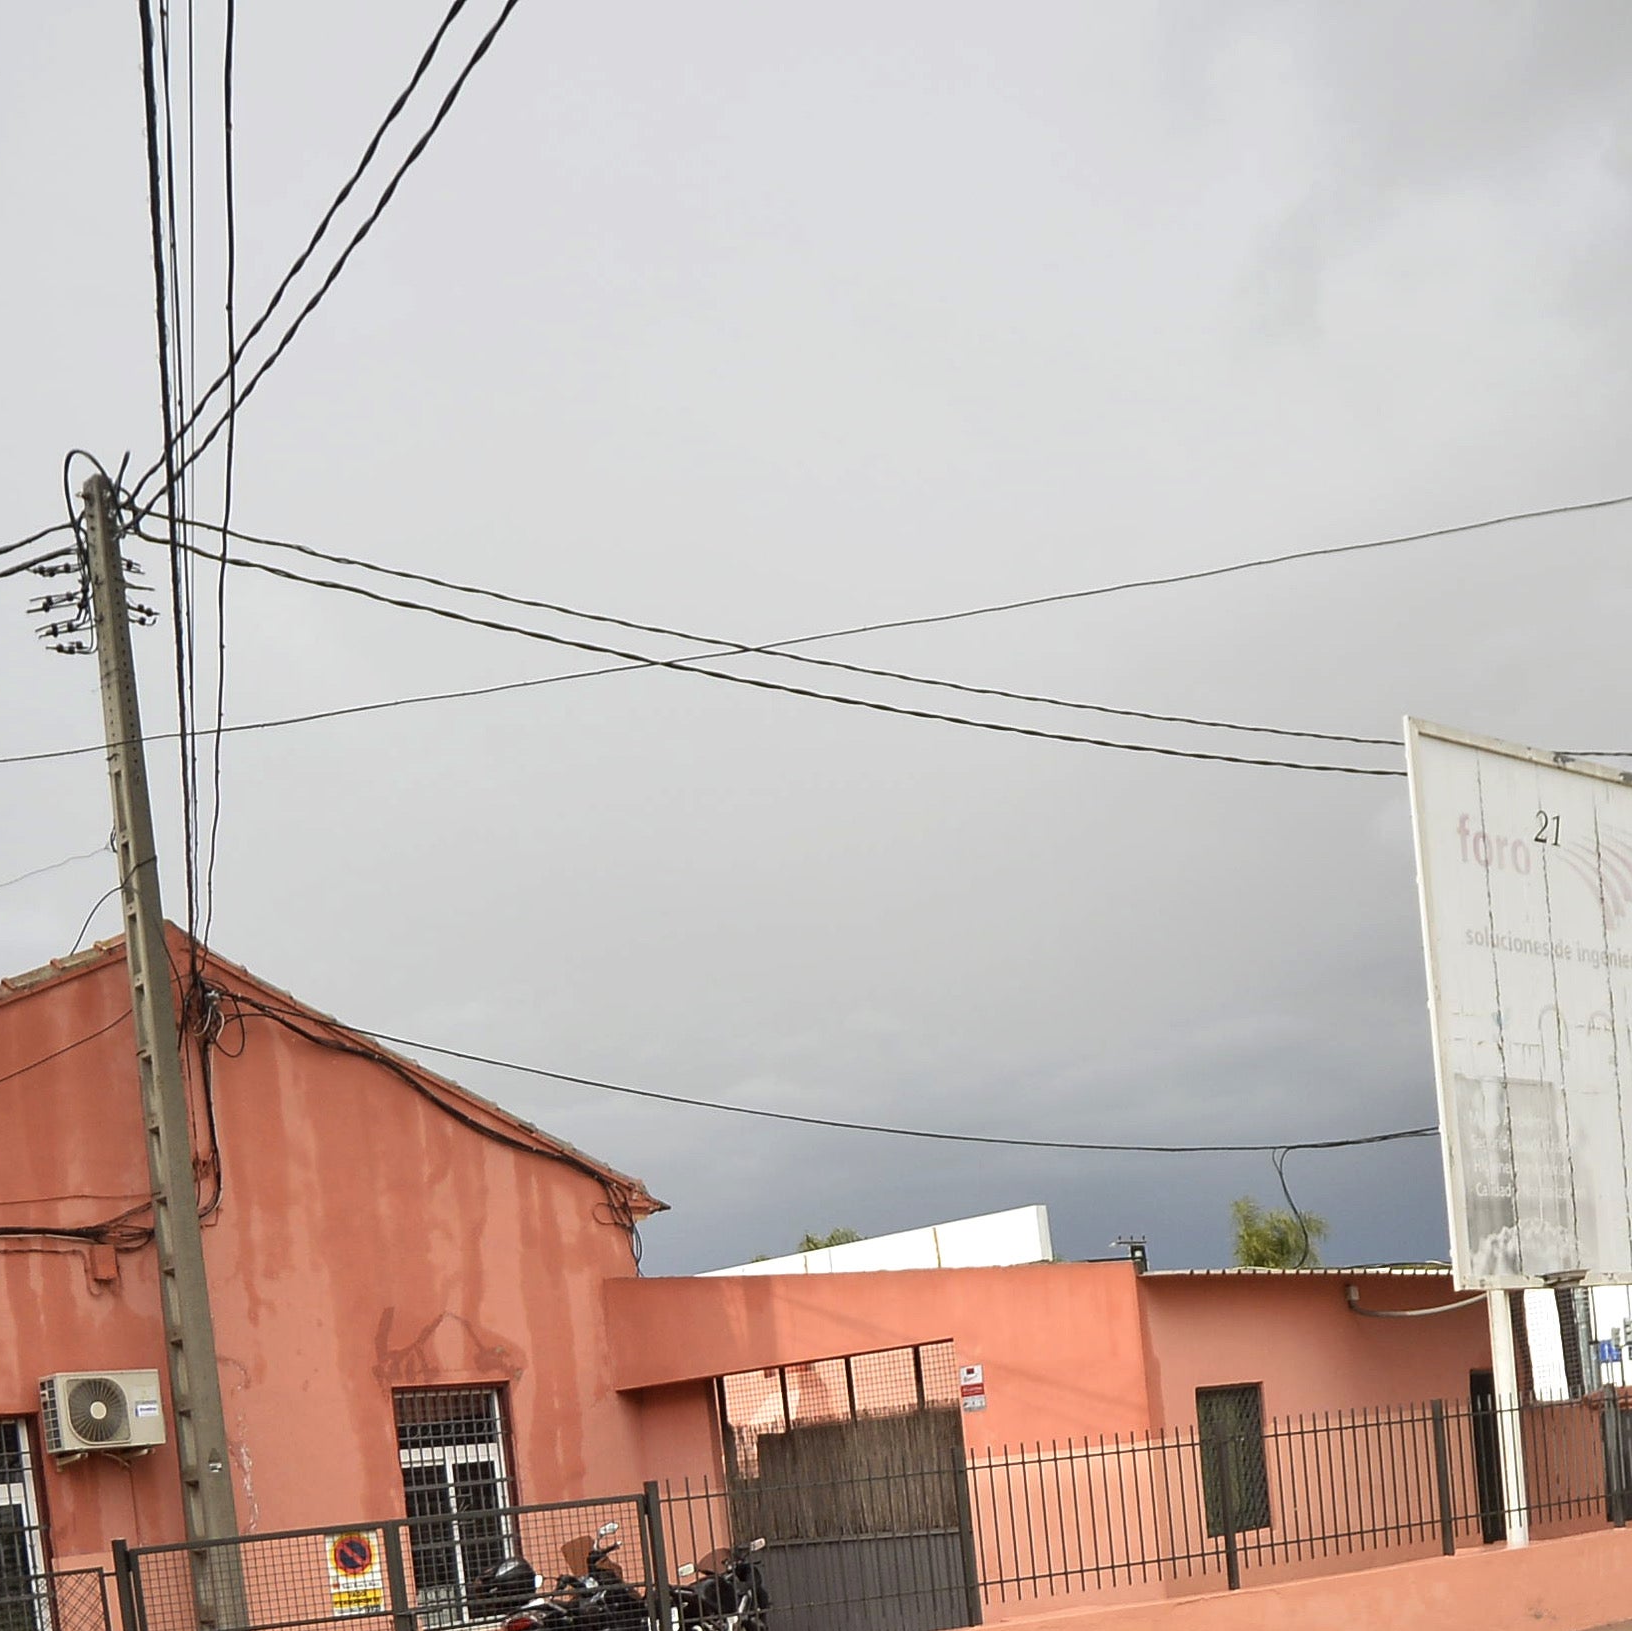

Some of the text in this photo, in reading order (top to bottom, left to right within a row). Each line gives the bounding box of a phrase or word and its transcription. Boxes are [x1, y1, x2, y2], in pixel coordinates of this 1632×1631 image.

[1457, 812, 1532, 875] foro
[1534, 810, 1562, 847] 21
[1466, 927, 1549, 957] soluciones
[1554, 939, 1573, 960] de
